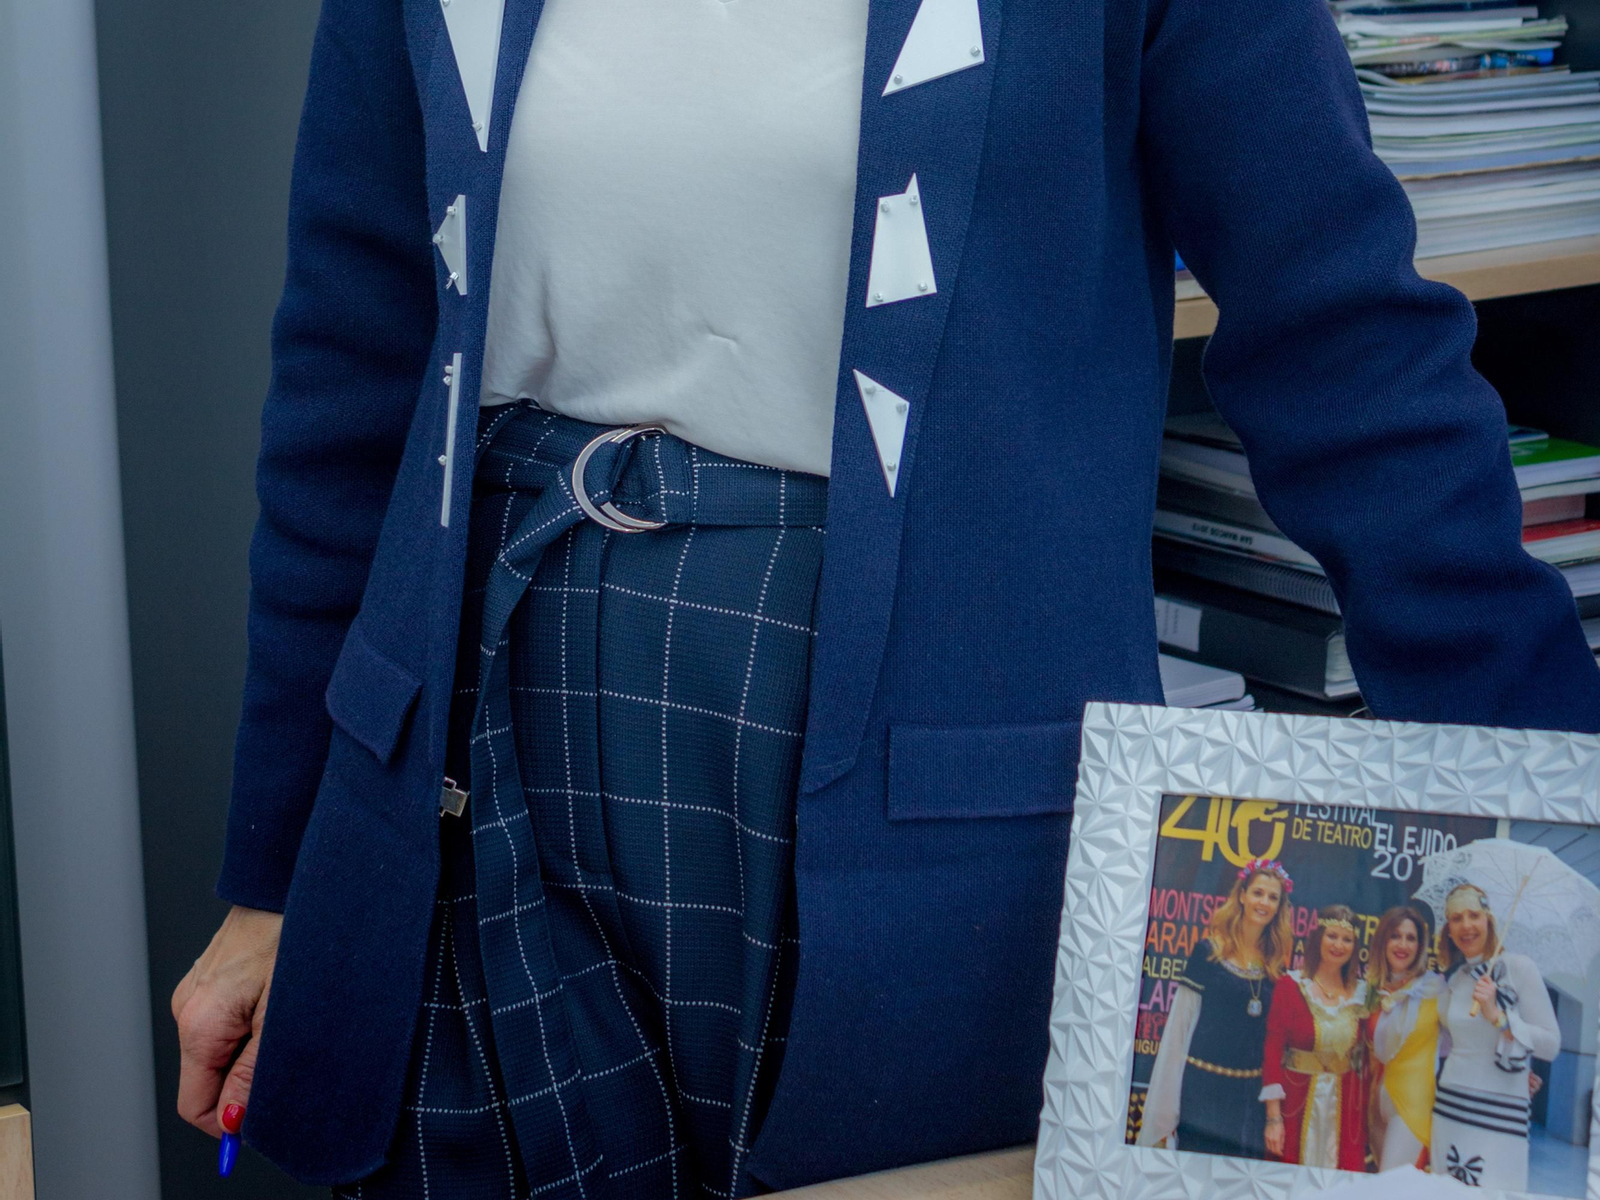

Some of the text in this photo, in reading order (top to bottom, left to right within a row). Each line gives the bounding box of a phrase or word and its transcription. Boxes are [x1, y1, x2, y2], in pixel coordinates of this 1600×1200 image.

[1292, 817, 1373, 850] DE TEATRO
[1374, 822, 1458, 856] EL EJIDO
[1370, 850, 1429, 882] 201
[1142, 955, 1188, 980] ALBE
